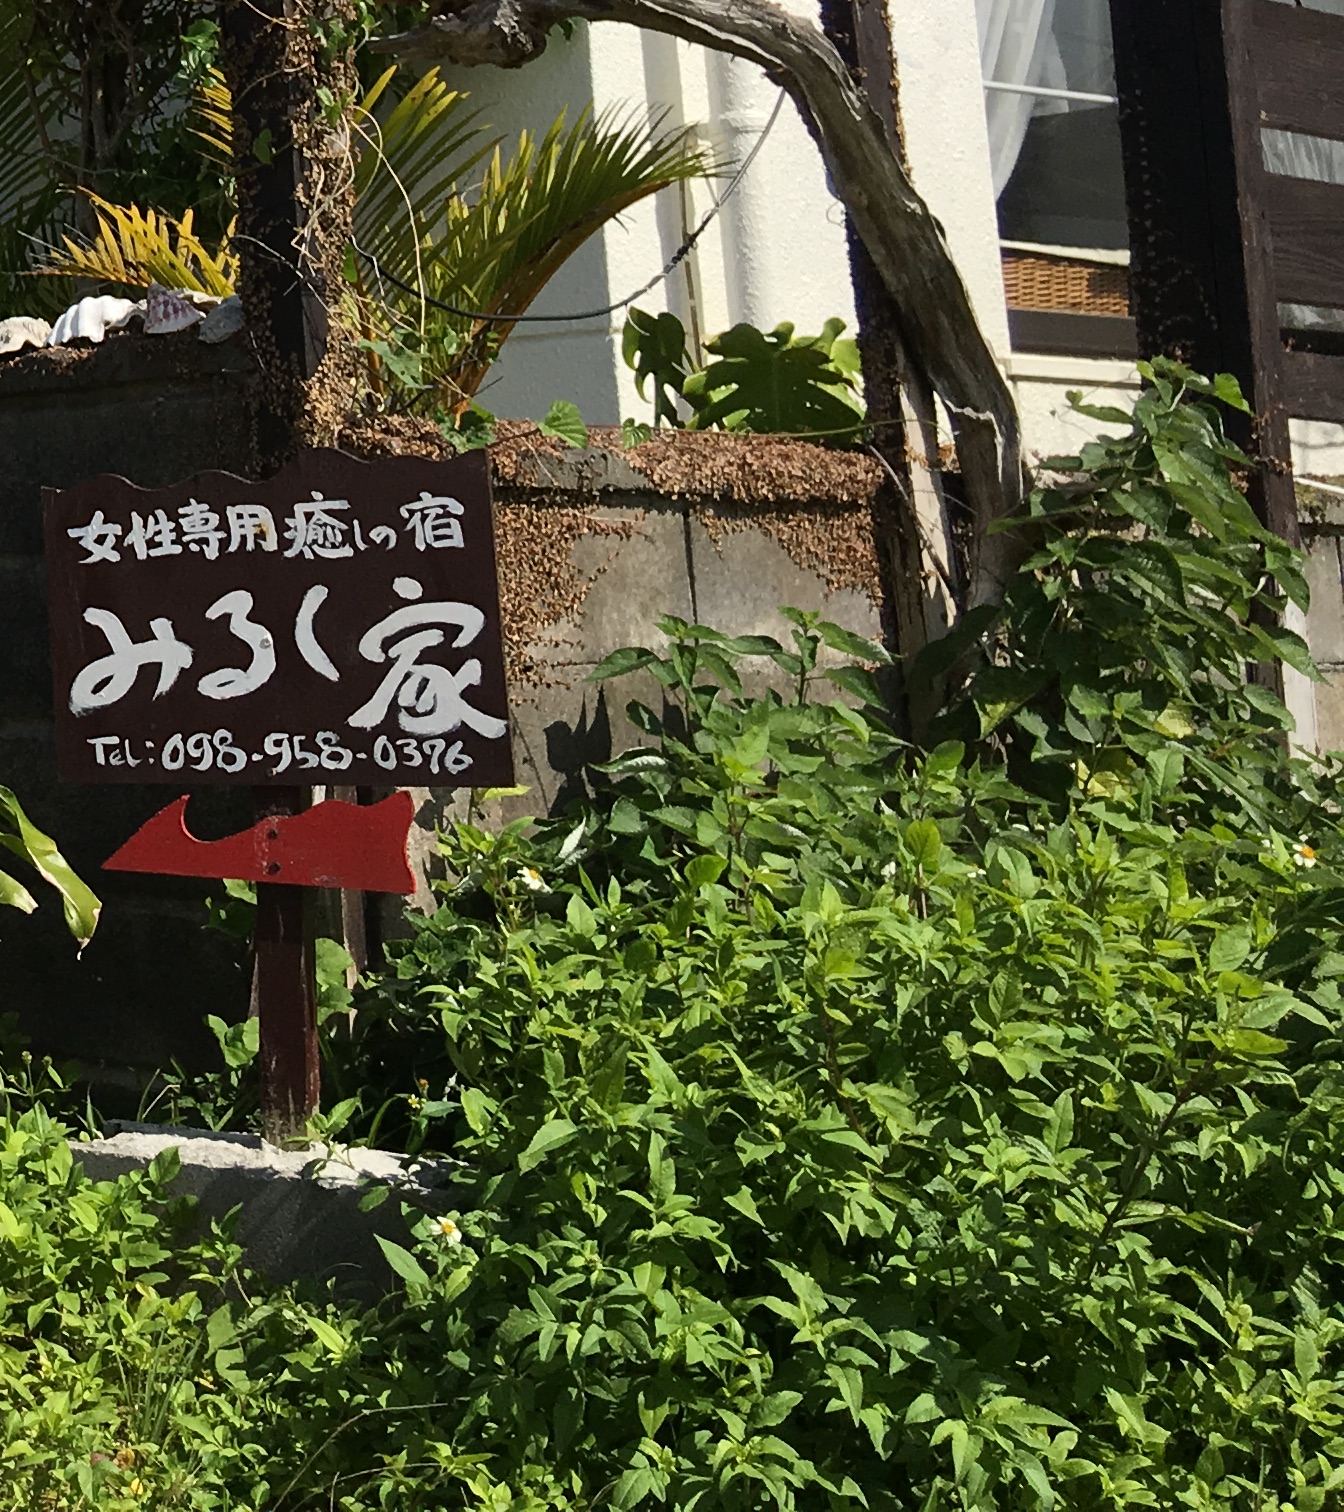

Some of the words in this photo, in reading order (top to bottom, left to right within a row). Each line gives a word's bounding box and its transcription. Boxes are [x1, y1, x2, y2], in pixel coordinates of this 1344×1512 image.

[69, 491, 465, 565] 女性専用癒しの宿
[68, 576, 507, 739] みるく家
